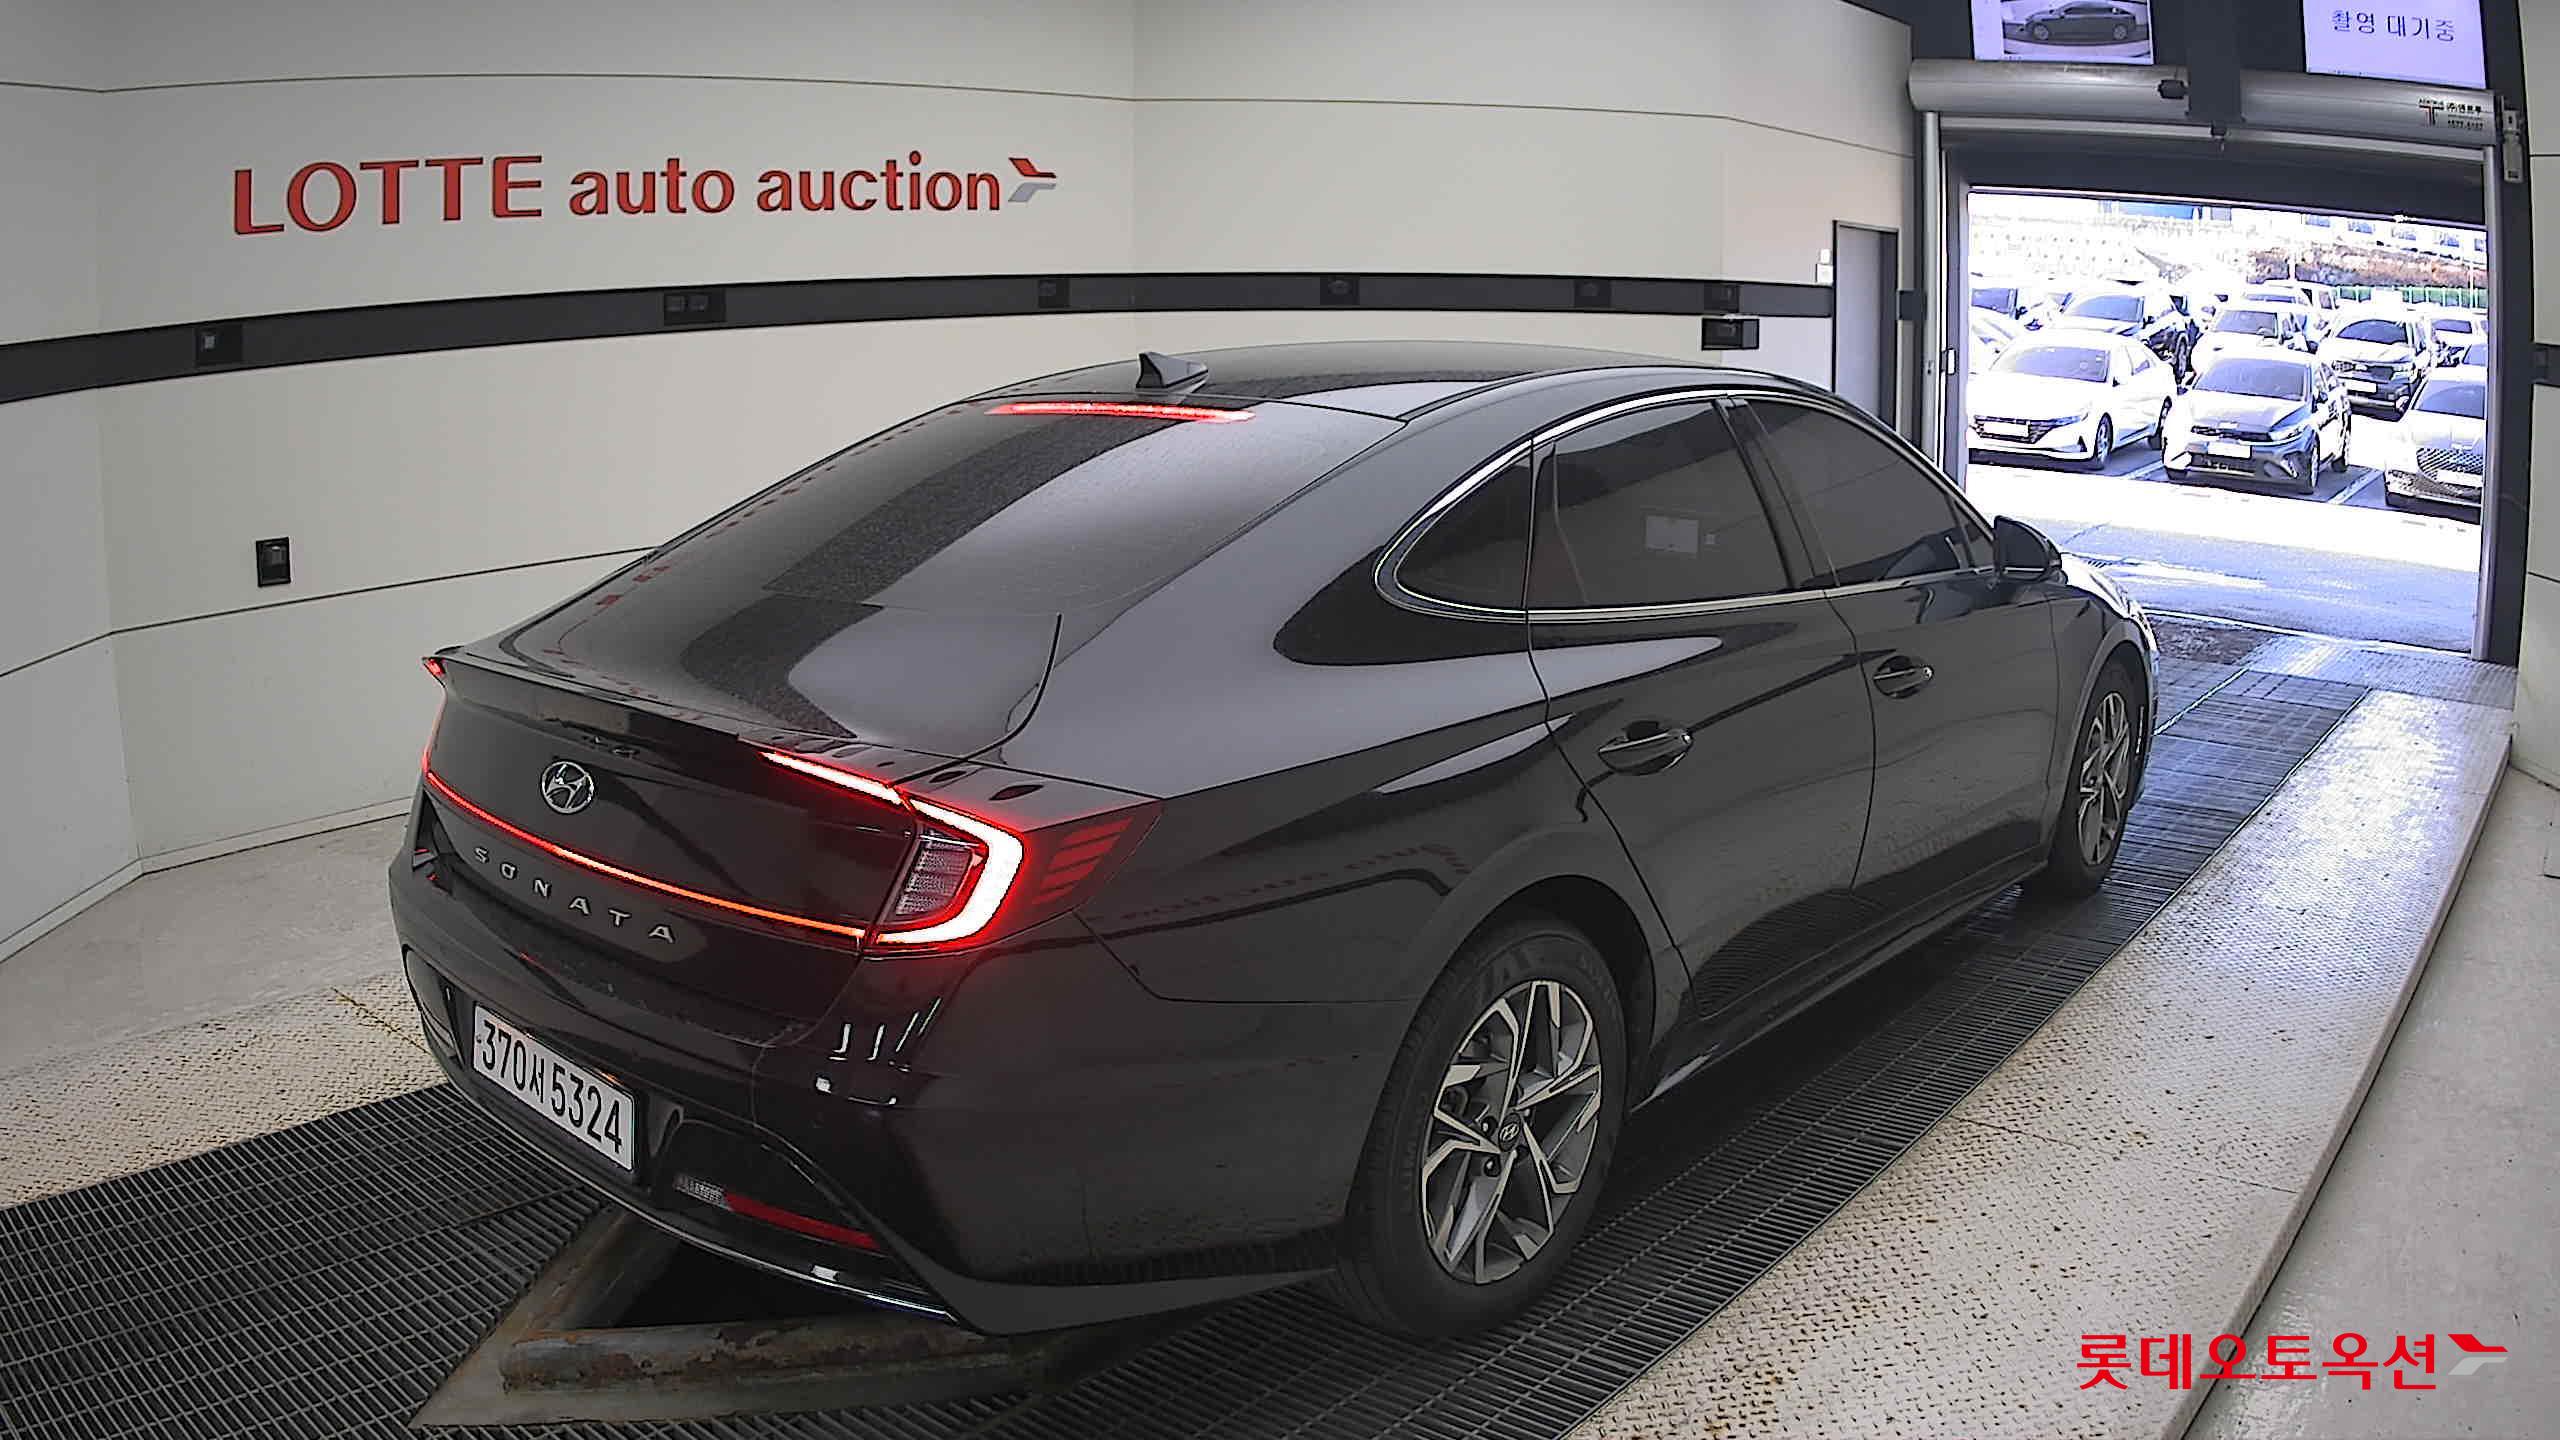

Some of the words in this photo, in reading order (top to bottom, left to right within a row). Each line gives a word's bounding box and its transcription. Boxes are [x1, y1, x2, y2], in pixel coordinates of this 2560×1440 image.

[2332, 10, 2375, 34] 촬영
[2387, 15, 2454, 42] 대기중
[234, 155, 542, 235] LOTTE
[568, 157, 735, 216] auto
[757, 150, 1000, 212] auction
[474, 846, 676, 944] SONATA
